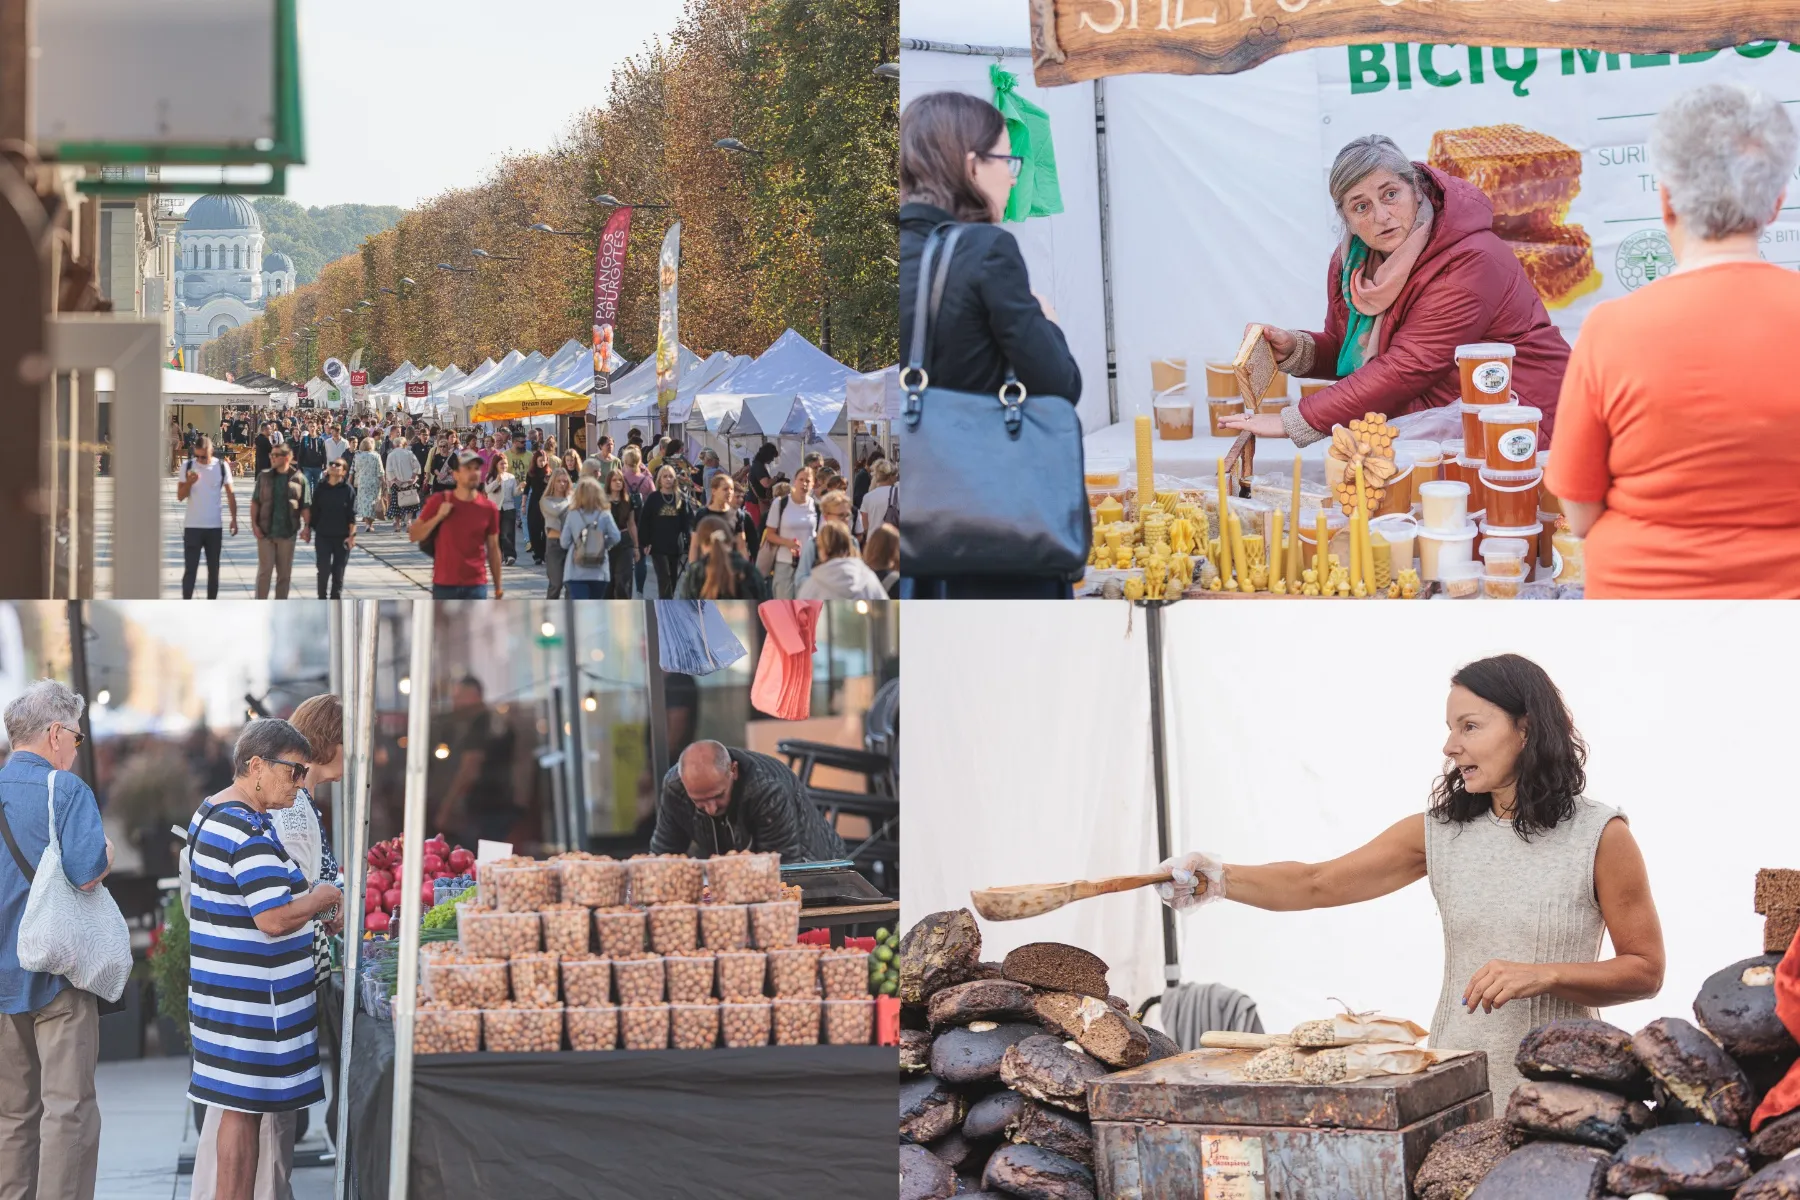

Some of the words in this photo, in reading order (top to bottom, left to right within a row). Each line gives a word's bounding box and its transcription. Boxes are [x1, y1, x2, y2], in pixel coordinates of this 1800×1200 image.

[1598, 145, 1650, 166] SURI
[596, 232, 614, 319] PALANGOS
[605, 230, 625, 320] SPURGYTES
